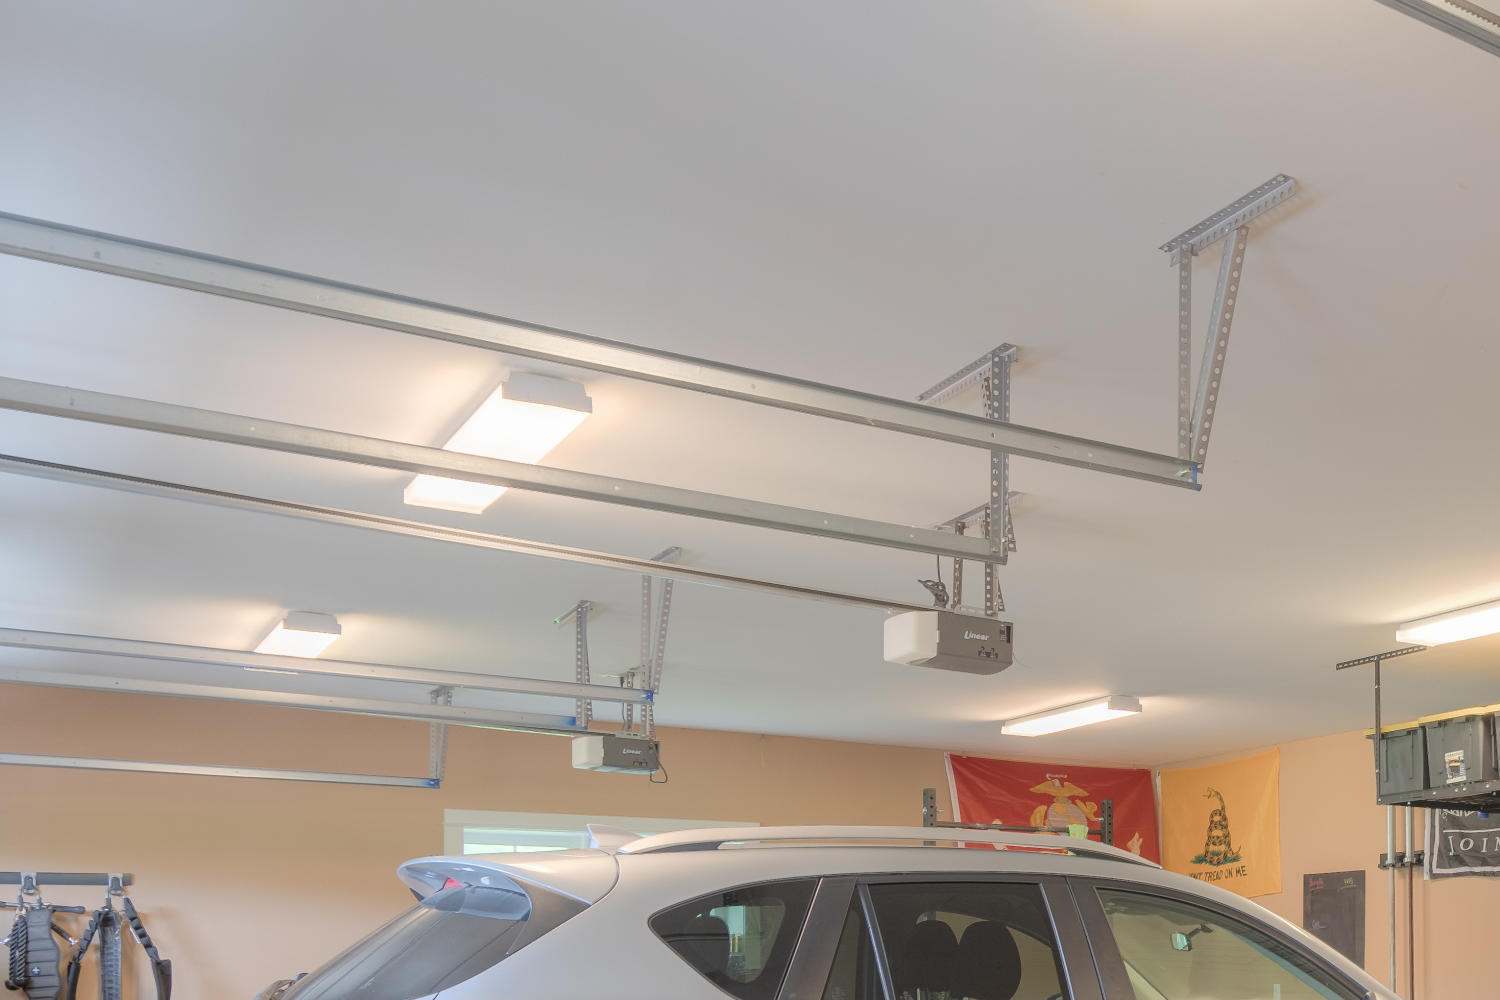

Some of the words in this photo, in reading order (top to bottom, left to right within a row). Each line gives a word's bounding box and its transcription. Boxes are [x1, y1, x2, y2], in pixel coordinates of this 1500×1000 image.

[964, 630, 990, 641] Linear
[1205, 869, 1224, 881] TREAD
[1225, 867, 1233, 879] ON
[1235, 865, 1247, 878] ME
